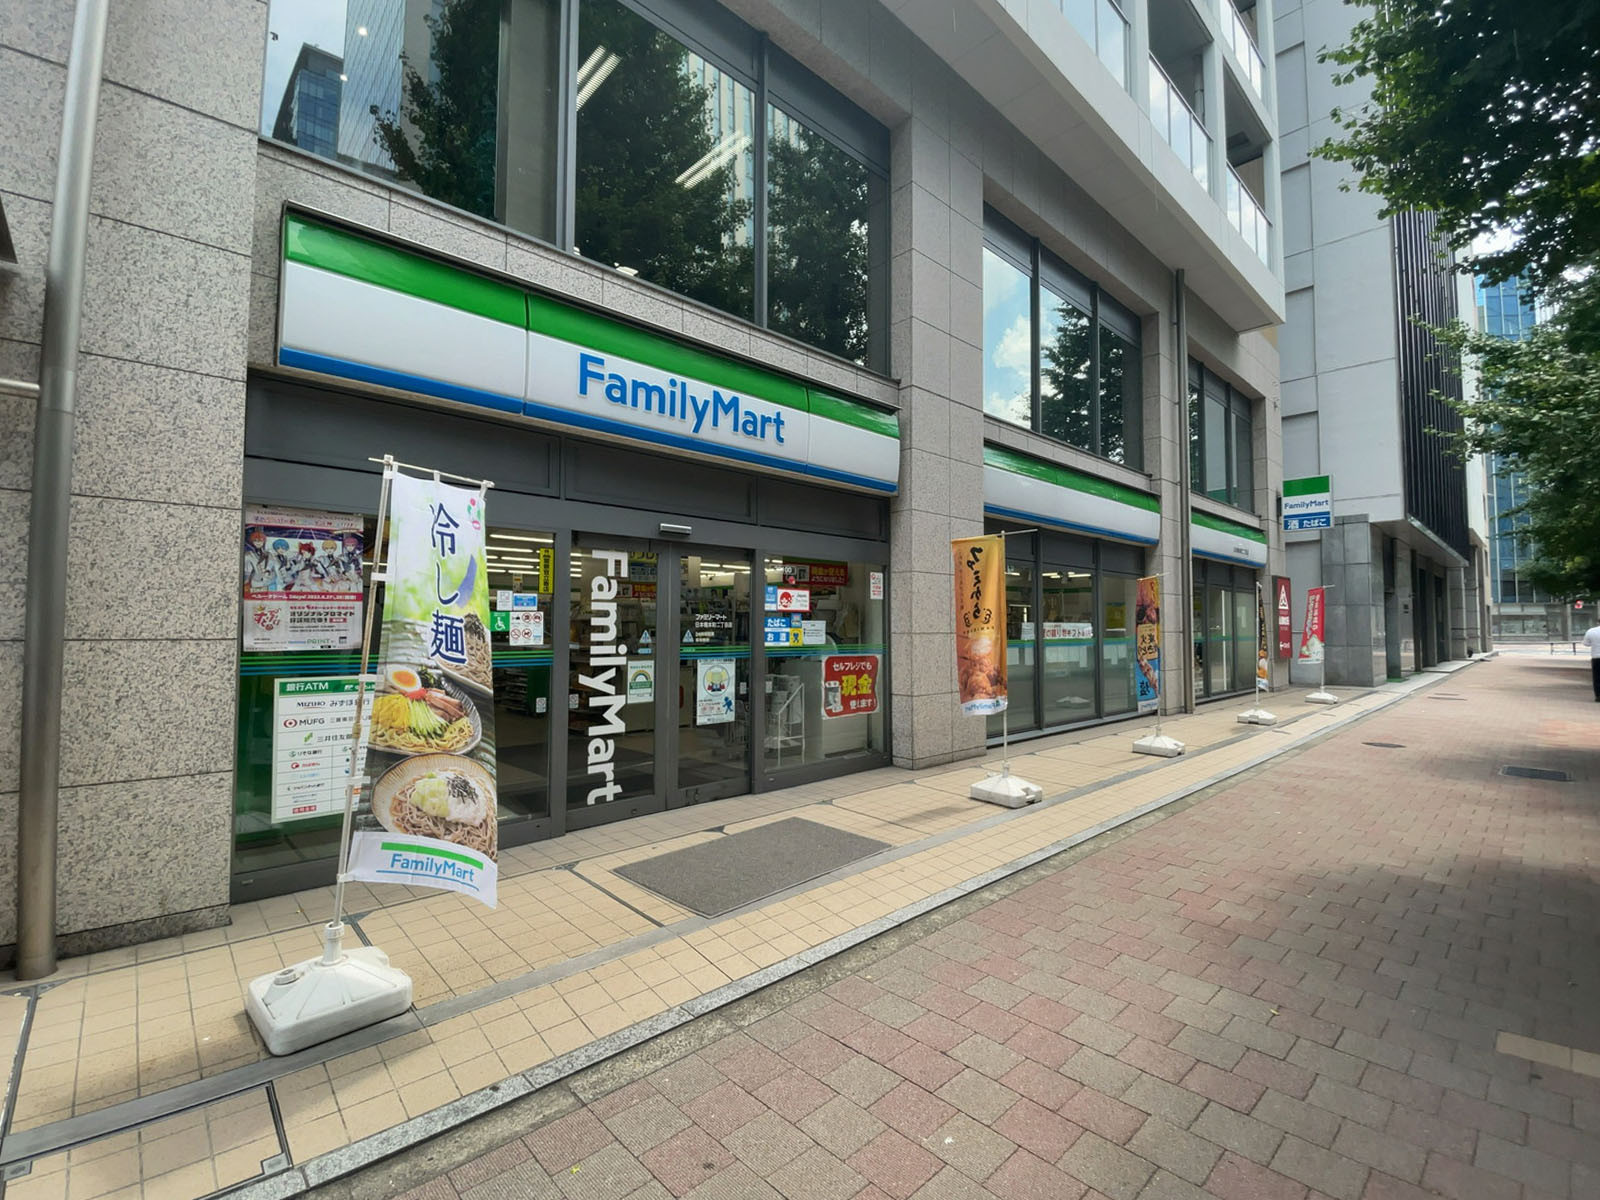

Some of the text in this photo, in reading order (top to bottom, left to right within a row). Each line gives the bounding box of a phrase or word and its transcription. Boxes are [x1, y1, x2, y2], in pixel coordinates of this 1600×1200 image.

[578, 352, 785, 444] FamilyMart
[1284, 498, 1329, 510] FamilyMart
[1302, 518, 1328, 528] たばこ
[429, 503, 468, 665] 冷し麺
[695, 613, 727, 621] ファミリーマート
[767, 618, 787, 628] たばこ
[833, 661, 873, 671] セルフレジでも
[578, 550, 629, 806] FamilyMart
[286, 682, 329, 692] 銀行ATM
[841, 673, 873, 697] 現金
[299, 718, 325, 726] MUFG
[390, 853, 475, 882] FamilyMart
